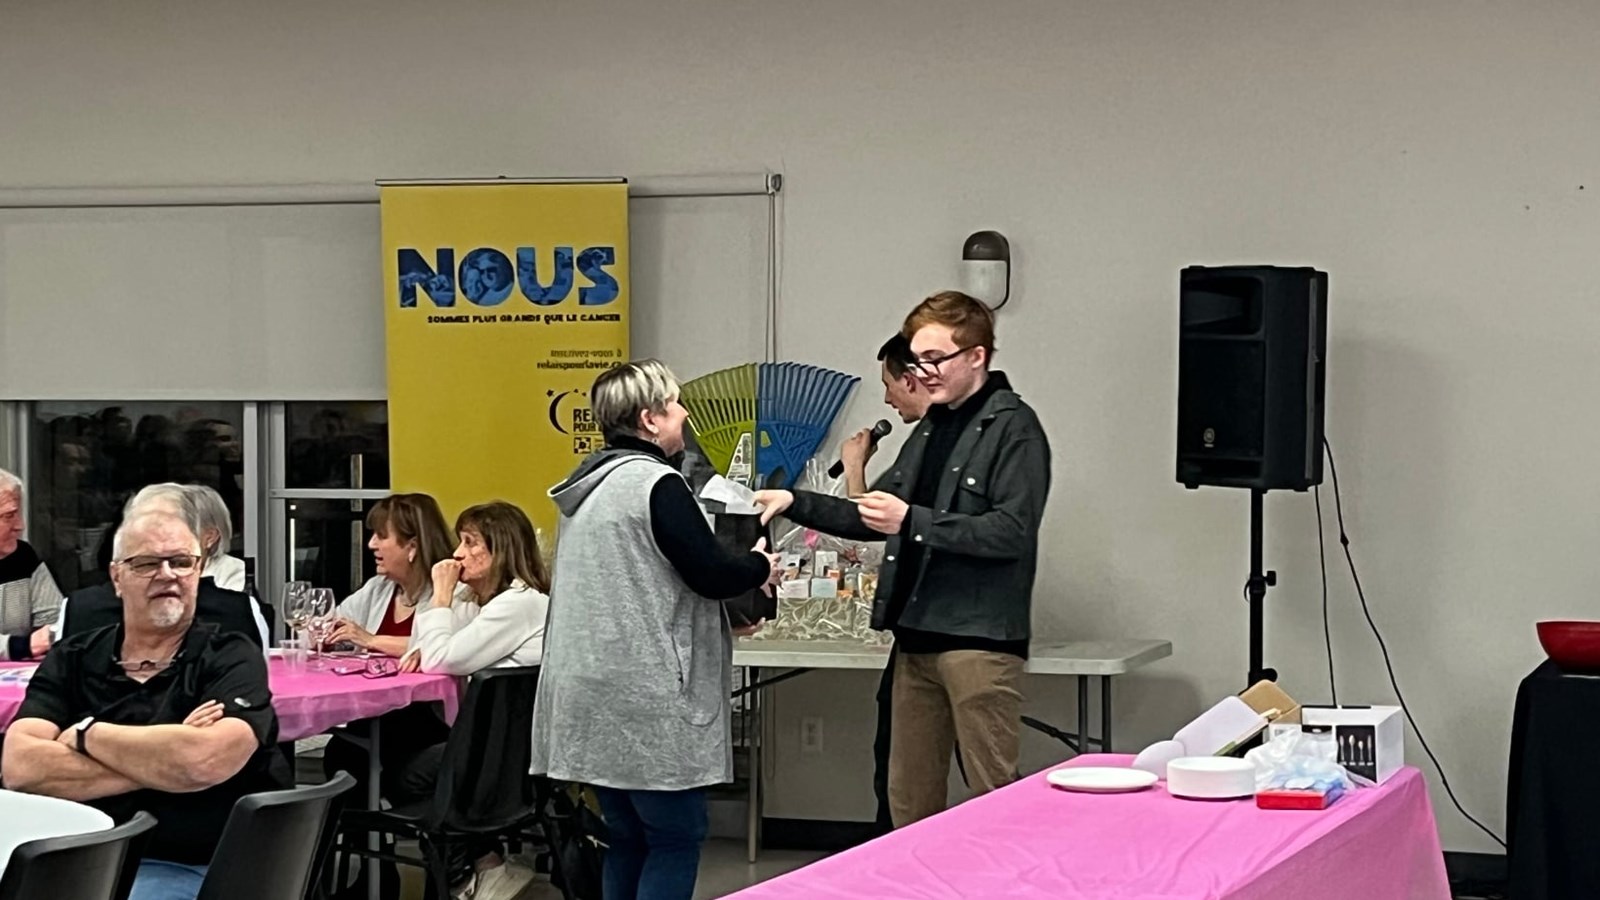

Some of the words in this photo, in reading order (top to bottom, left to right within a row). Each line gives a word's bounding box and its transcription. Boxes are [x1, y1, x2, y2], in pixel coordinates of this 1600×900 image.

[397, 247, 619, 308] NOUS
[427, 315, 470, 324] SOMMES
[472, 314, 497, 323] PLUS
[500, 314, 541, 323] GRANDS
[543, 314, 563, 325] QUE
[566, 313, 577, 322] LE
[580, 313, 621, 322] CANCER
[573, 422, 597, 432] POUR
